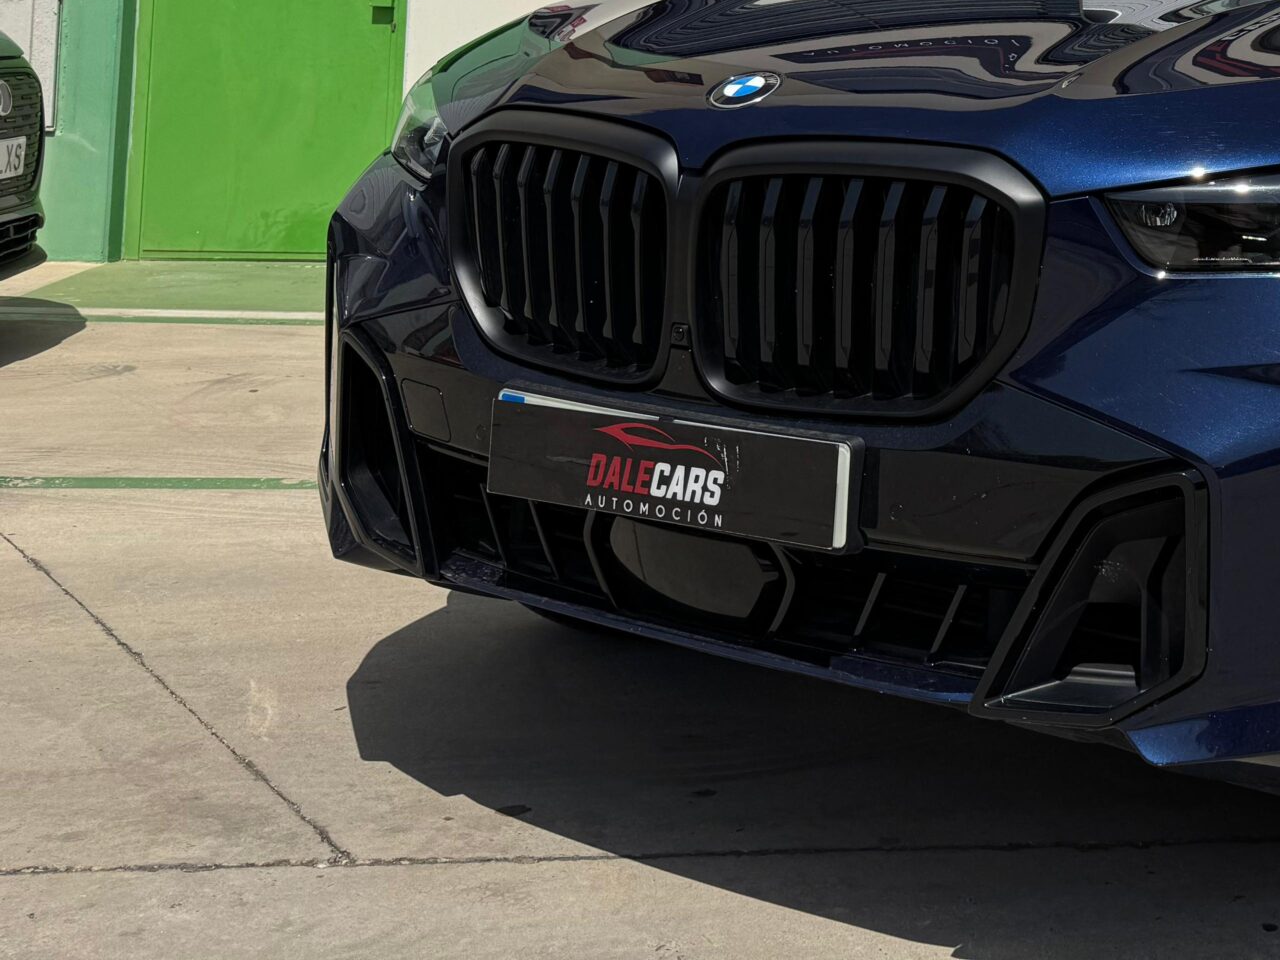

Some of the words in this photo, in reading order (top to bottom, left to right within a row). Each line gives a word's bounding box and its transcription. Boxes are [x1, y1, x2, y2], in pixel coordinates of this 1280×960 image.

[0, 143, 22, 174] XS
[585, 452, 726, 507] DALECARS
[584, 493, 724, 528] AUTOMOCIÓN
